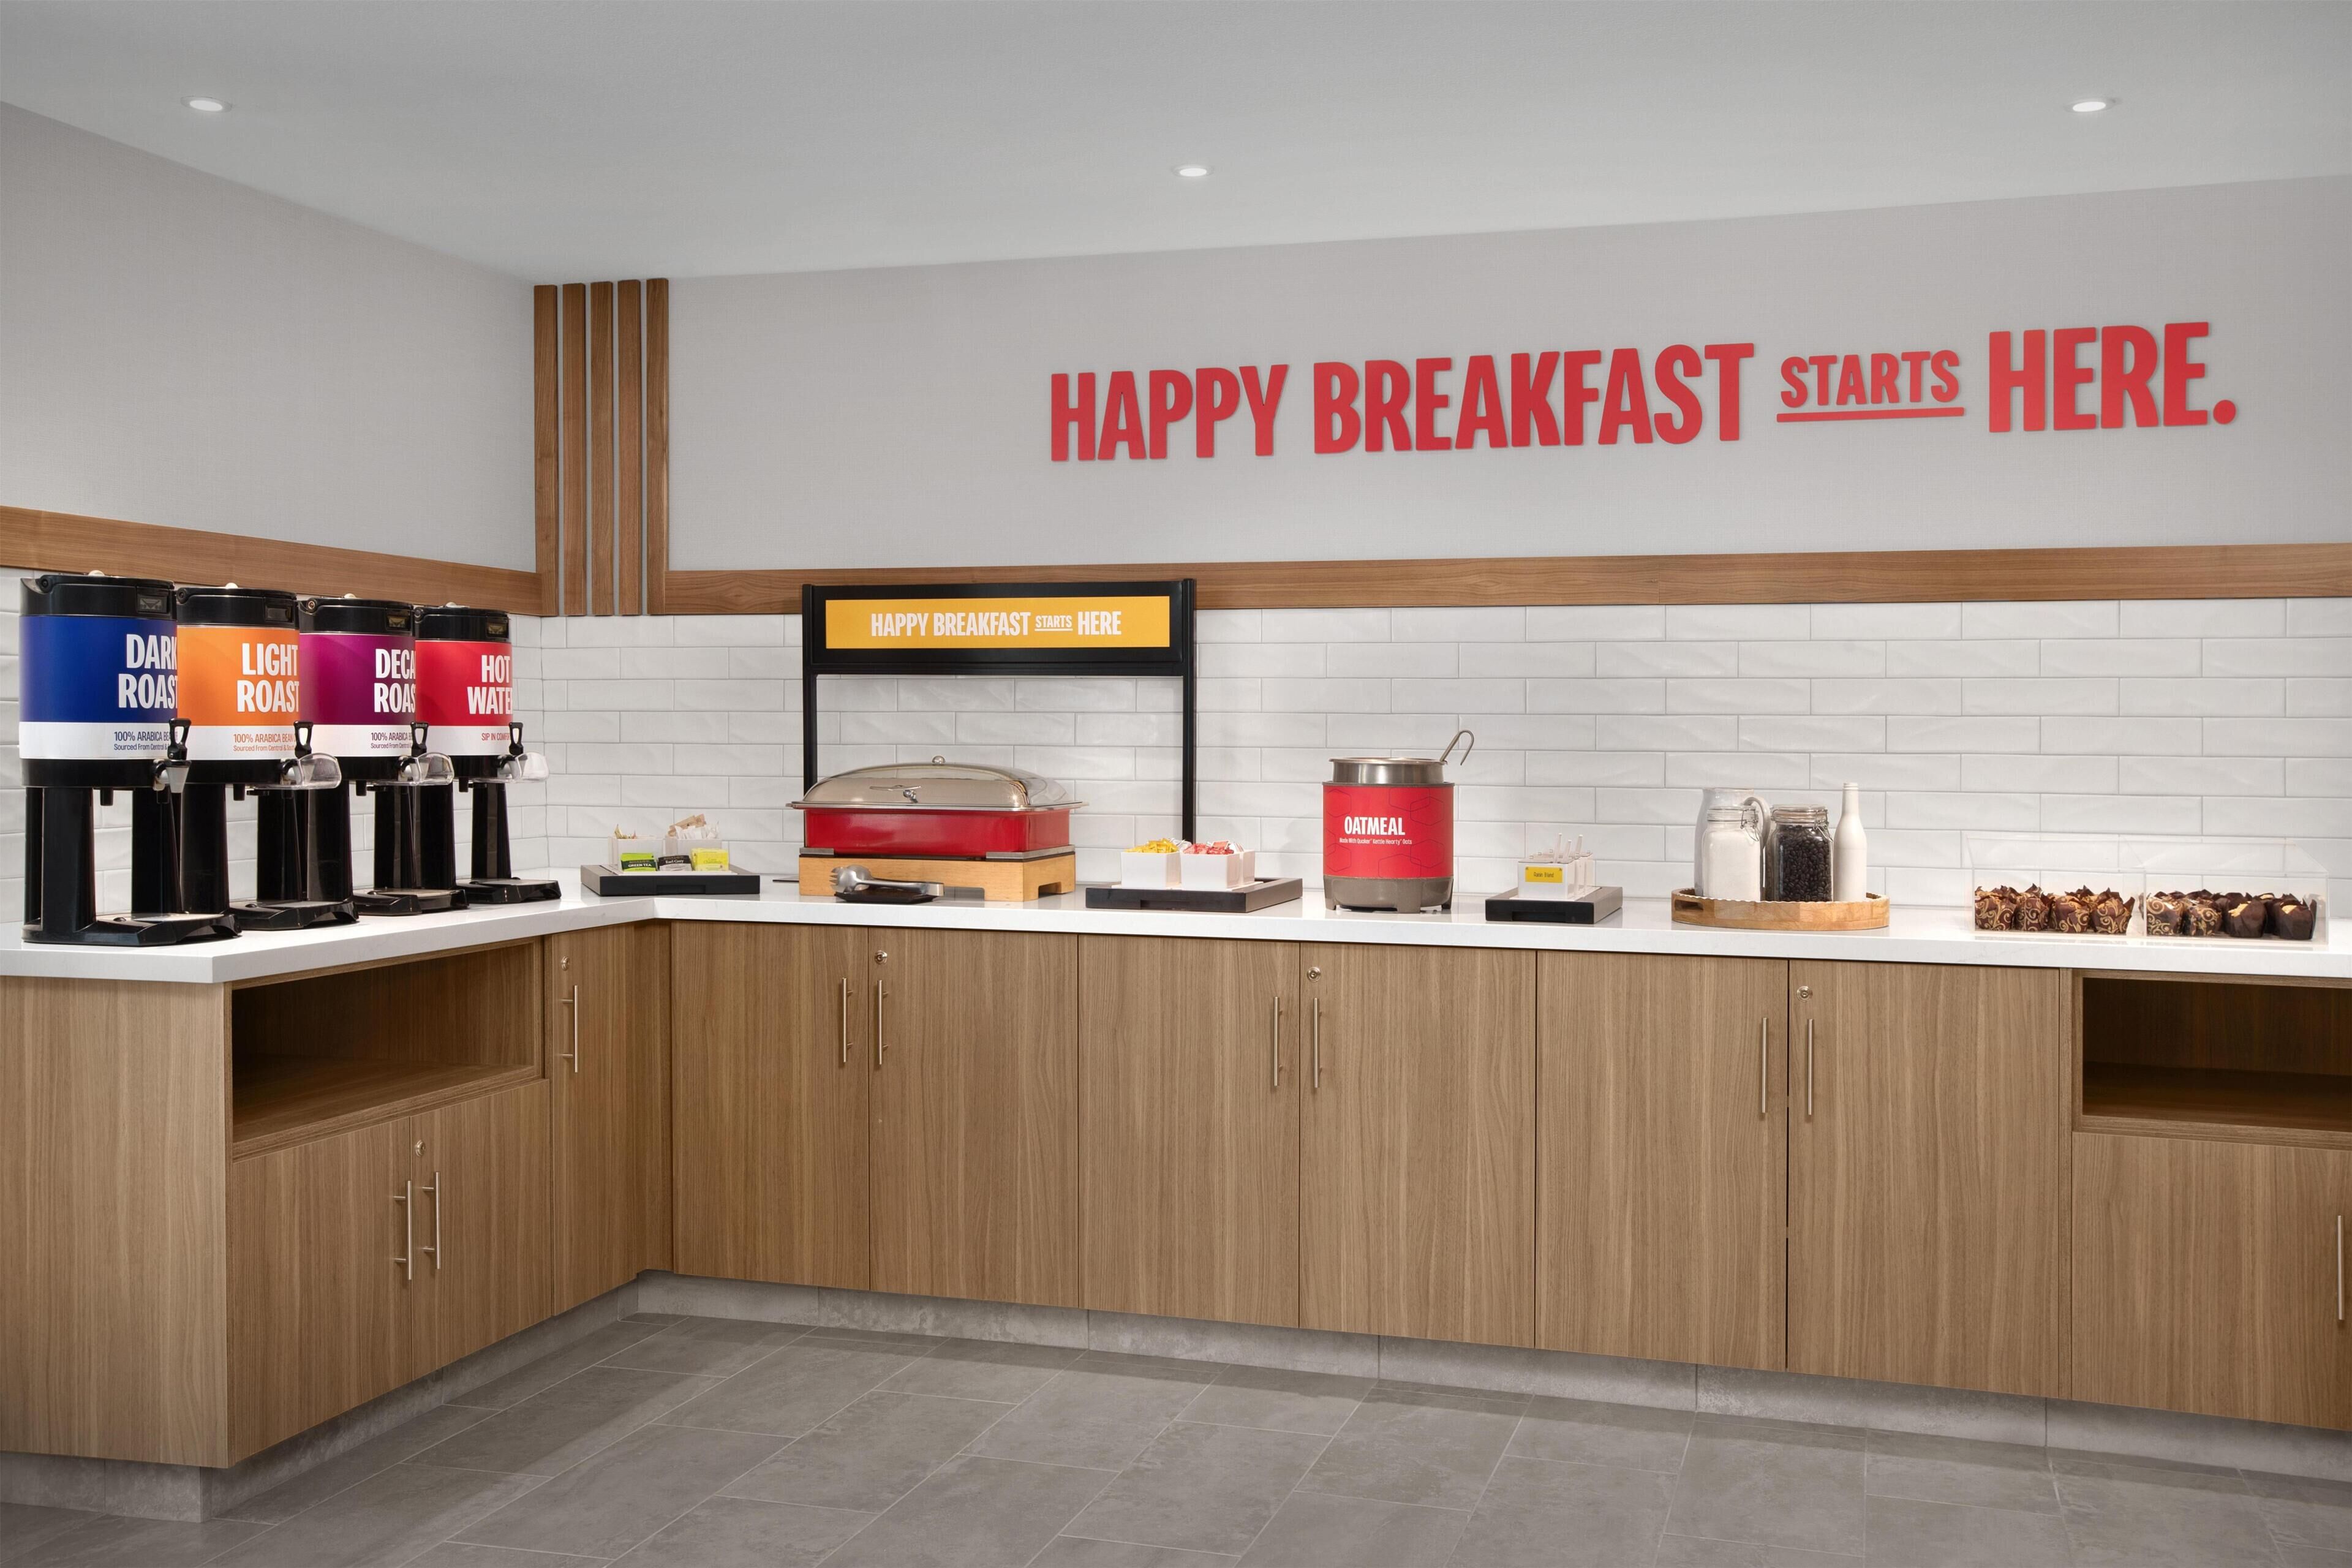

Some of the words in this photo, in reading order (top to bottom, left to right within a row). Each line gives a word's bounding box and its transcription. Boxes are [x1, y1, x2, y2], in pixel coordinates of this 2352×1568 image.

[1051, 364, 1289, 462] HAPPY
[1313, 343, 1755, 454] BREAKFAST
[1781, 350, 1959, 408] STARTS
[1989, 322, 2237, 432] HERE.
[871, 612, 929, 636] HAPPY
[933, 611, 1031, 636] BREAKFAST
[1035, 615, 1072, 628] STARTS
[1077, 611, 1121, 635] HERE
[126, 634, 177, 670] DARK
[243, 643, 298, 676] LIGHT
[375, 649, 416, 679] DECA
[481, 655, 510, 683] HOT
[236, 680, 300, 713] ROAST
[374, 682, 416, 713] ROAS
[114, 731, 135, 741] 100%
[137, 731, 162, 741] ARABICA
[233, 734, 254, 743] 100%
[255, 734, 281, 742] ARABICA
[371, 732, 388, 741] 100%
[388, 732, 408, 741] ARABICA
[481, 733, 490, 741] SIP
[1344, 816, 1406, 835] OATMEAL
